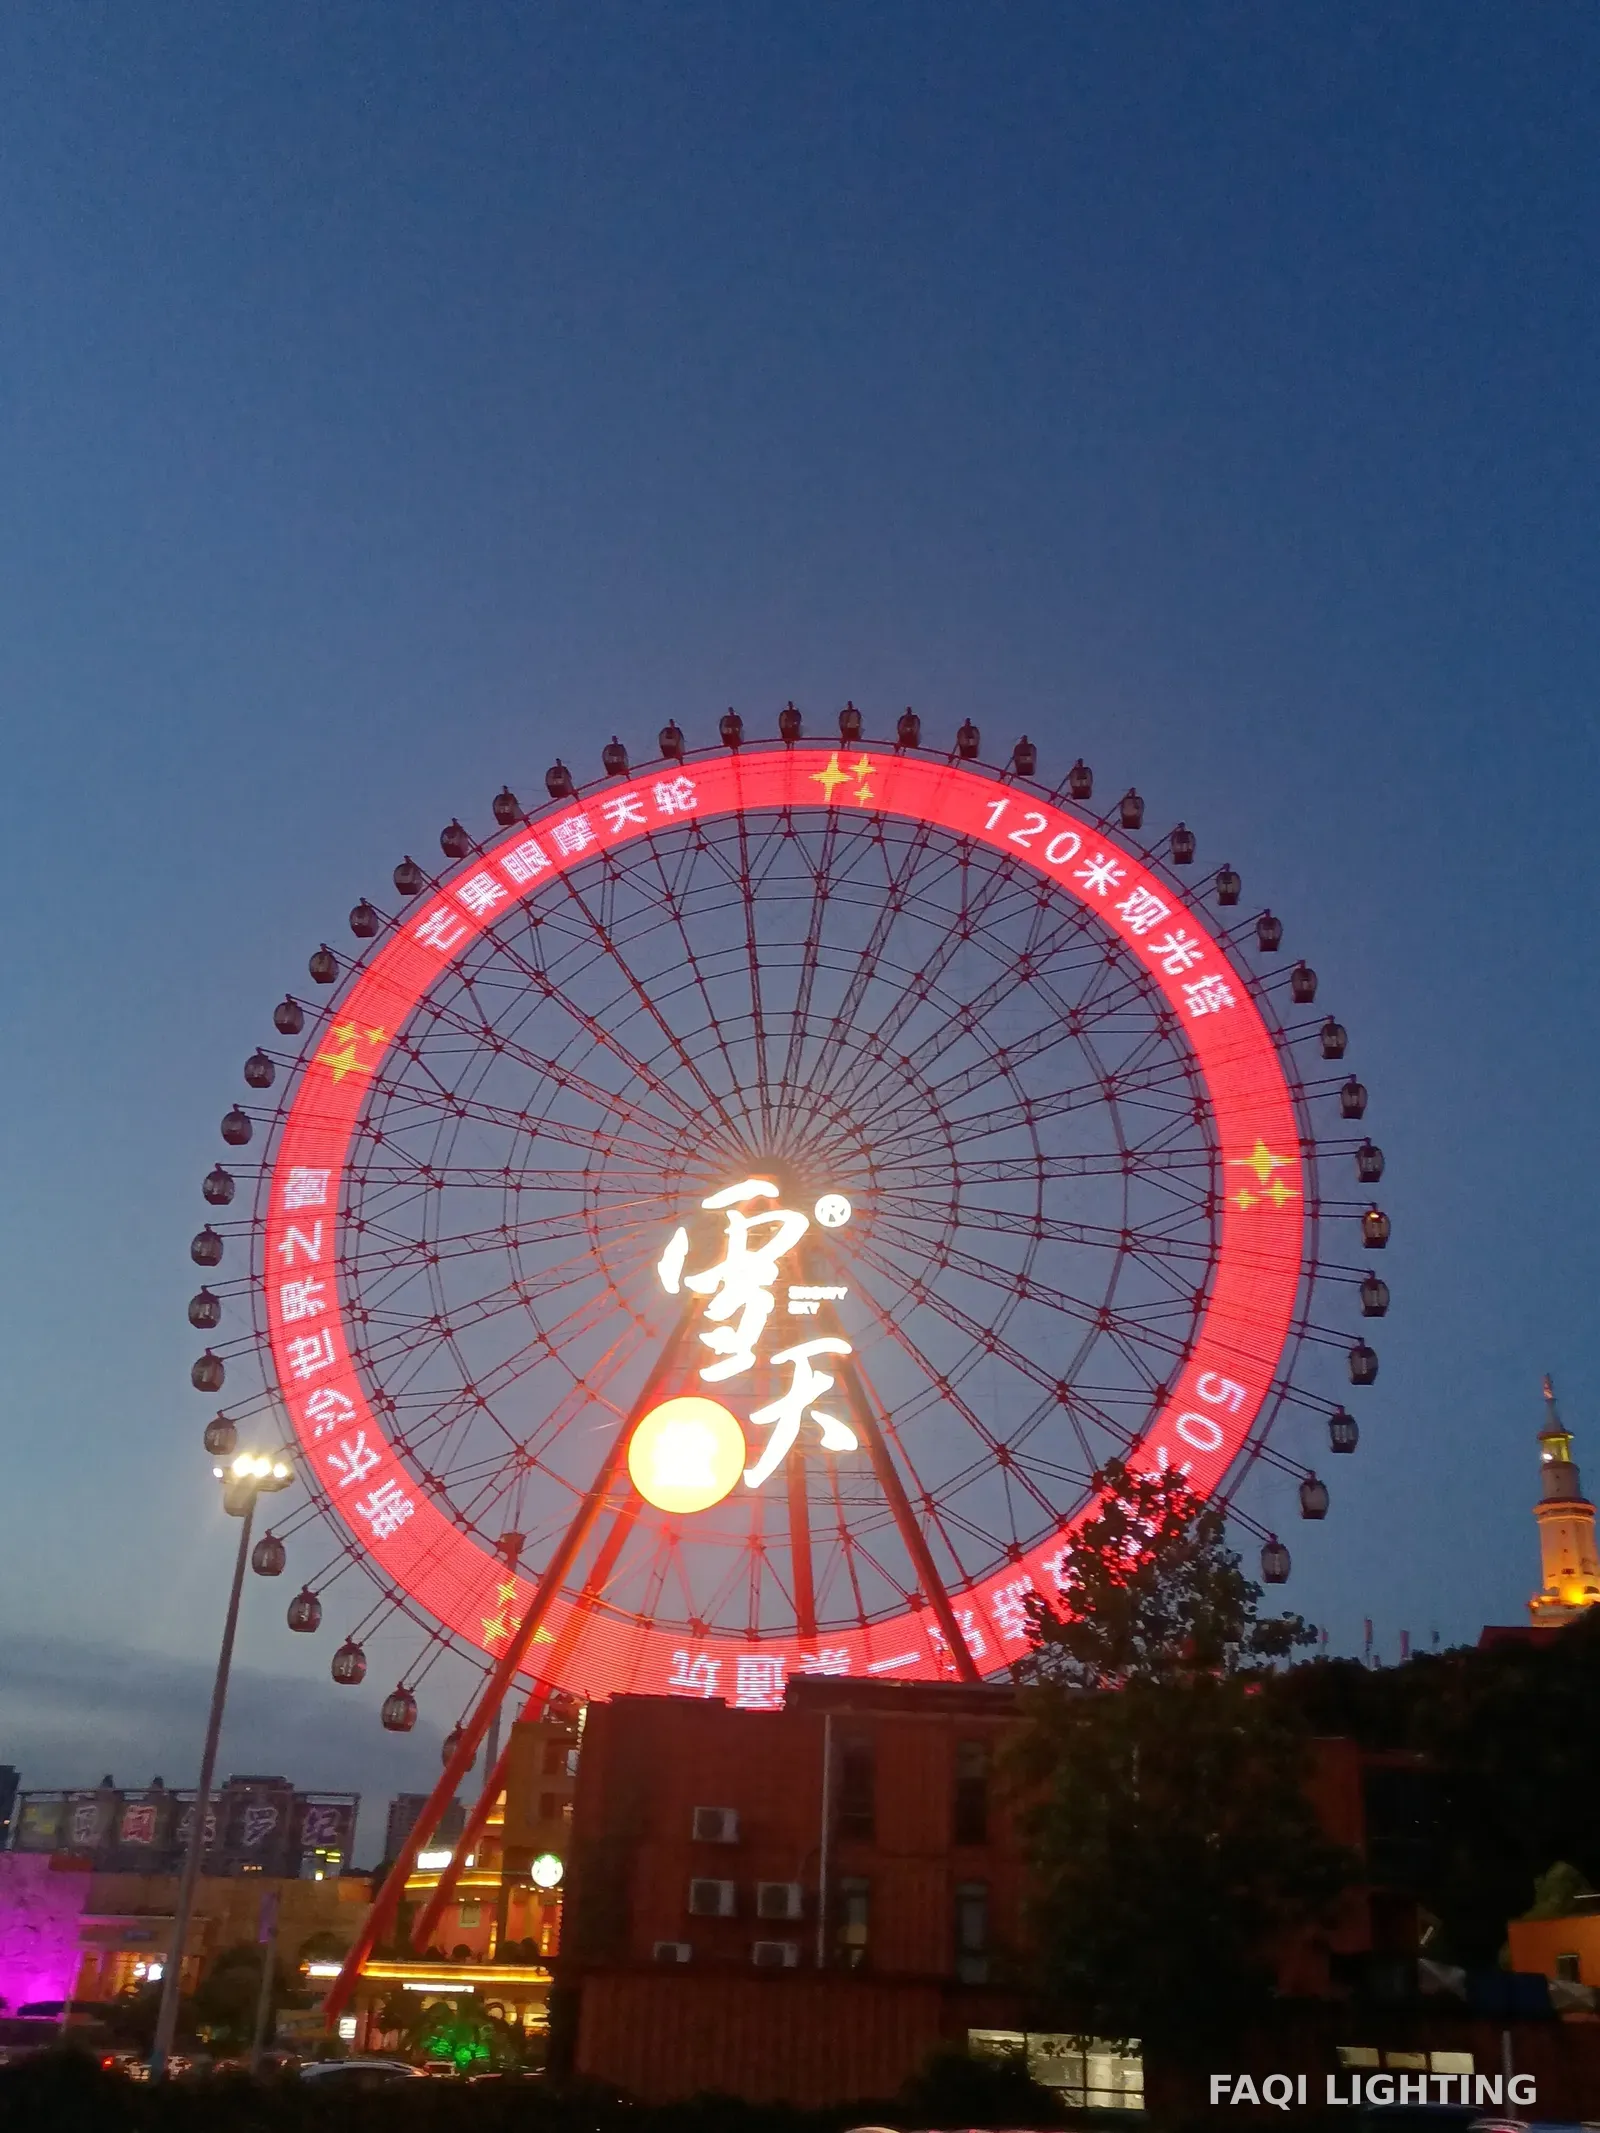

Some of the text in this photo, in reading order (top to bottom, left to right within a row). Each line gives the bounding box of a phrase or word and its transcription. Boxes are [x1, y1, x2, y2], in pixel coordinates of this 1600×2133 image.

[413, 775, 699, 952] 芒果眼摩天轮
[984, 798, 1236, 1018] 120米观光塔
